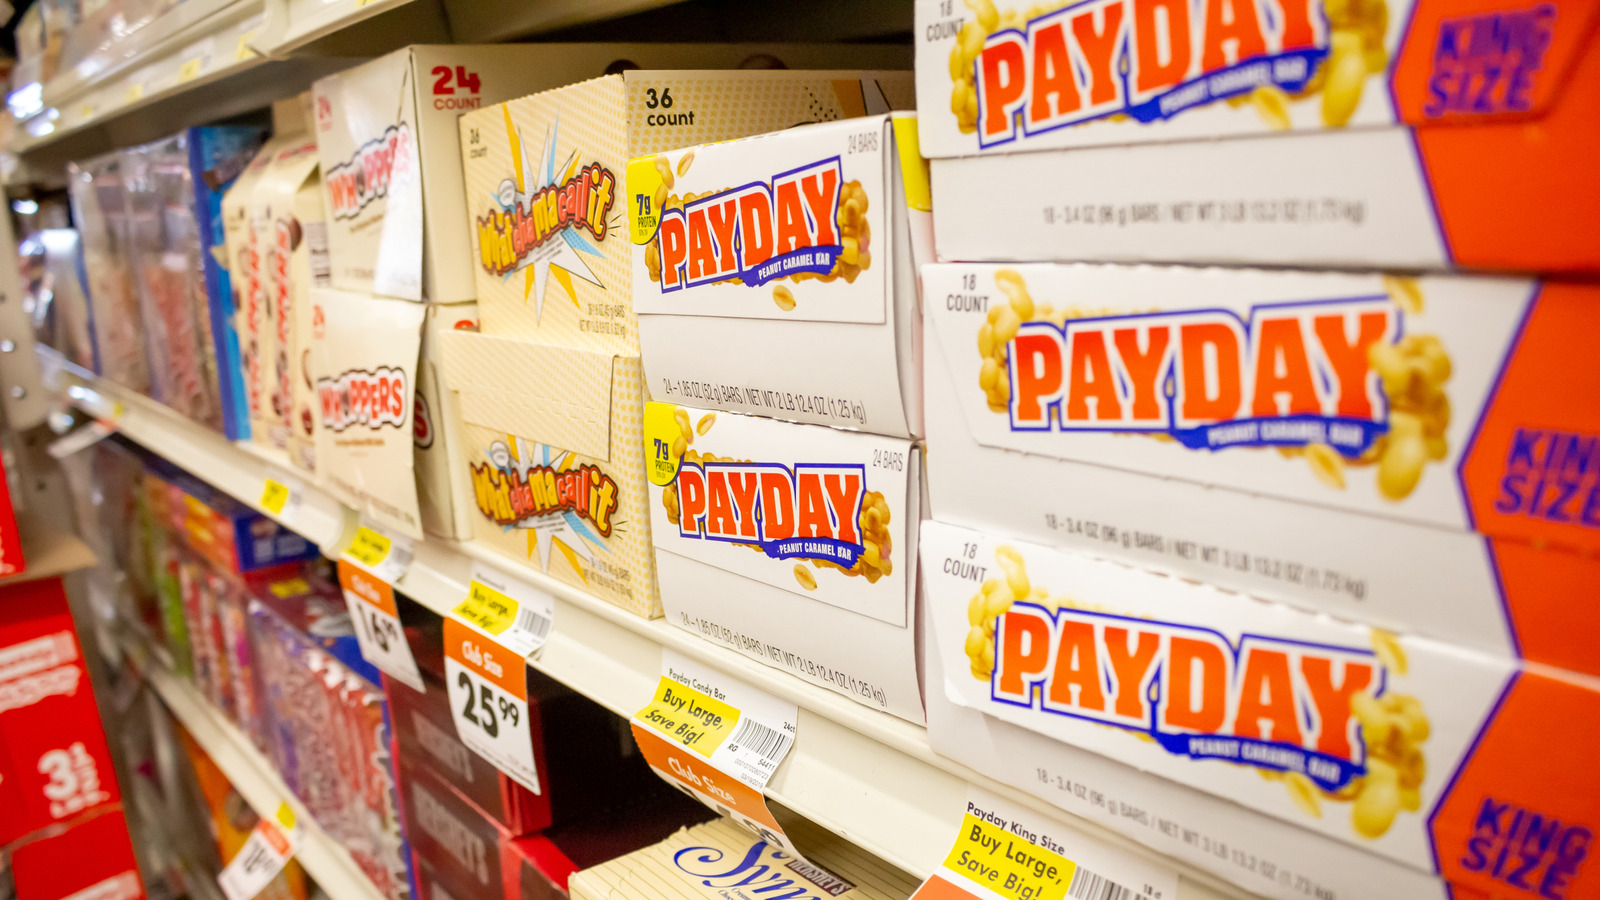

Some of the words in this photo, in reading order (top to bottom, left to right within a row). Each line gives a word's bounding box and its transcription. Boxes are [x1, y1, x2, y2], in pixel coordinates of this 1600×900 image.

[927, 18, 964, 42] COUNT
[1436, 3, 1557, 70] KING
[431, 65, 481, 96] 24
[1424, 66, 1533, 118] SIZE
[434, 97, 482, 111] COUNT
[646, 88, 673, 109] 36
[647, 110, 695, 127] count
[848, 135, 857, 154] 24
[858, 132, 878, 153] BARS
[636, 194, 651, 216] 7g
[637, 216, 657, 228] PROTEIN
[658, 168, 838, 287] PAYDAY
[758, 260, 782, 281] PEANUT
[782, 254, 814, 272] CARAMEL
[815, 251, 830, 266] BAR
[963, 274, 976, 290] 18
[946, 294, 989, 313] COUNT
[1012, 310, 1390, 422] PAYDAY
[691, 381, 703, 399] OZ
[721, 385, 743, 404] BARS
[745, 388, 762, 407] NET
[760, 390, 777, 408] WT
[775, 392, 784, 410] 2
[781, 392, 796, 412] LB
[795, 394, 815, 414] 12.4
[814, 396, 828, 416] OZ
[827, 397, 851, 420] (1.25
[850, 400, 868, 425] kg)
[653, 438, 669, 461] 7g
[655, 459, 675, 474] PROTEIN
[873, 448, 884, 468] 24
[884, 451, 903, 472] BARS
[1508, 428, 1600, 475] KIN
[677, 469, 861, 545] PAYDAY
[779, 542, 803, 556] PEANUT
[804, 542, 836, 557] CARAMEL
[837, 545, 852, 561] BAR
[963, 542, 978, 560] 18
[943, 557, 988, 584] COUNT
[668, 667, 691, 688] Payday
[692, 678, 713, 697] Candy
[713, 688, 727, 702] Bar
[741, 634, 764, 656] BARS
[766, 645, 783, 663] NET
[782, 649, 797, 670] WT
[796, 656, 805, 672] 2
[803, 658, 817, 677] LB
[816, 663, 836, 685] 12.4
[834, 670, 849, 690] OZ
[848, 675, 872, 700] (1.25
[870, 685, 888, 708] kg)
[998, 610, 1375, 760] PAYDAY
[663, 687, 686, 712] Buy
[688, 699, 724, 731] Large,
[645, 708, 675, 730] Save
[674, 722, 705, 746] Big!
[727, 743, 739, 753] RG
[667, 756, 703, 787] Club
[702, 775, 738, 806] Size
[1036, 768, 1049, 784] 18
[1074, 783, 1088, 800] OZ
[1119, 801, 1149, 827] BARS
[1157, 818, 1180, 840] NET
[967, 801, 1007, 831] Payday
[1010, 821, 1037, 845] King
[1041, 835, 1065, 855] Size
[1476, 797, 1592, 864] KING
[969, 824, 1002, 856] Buy
[1005, 841, 1062, 885] Large,
[1461, 837, 1568, 900] SIZE
[957, 850, 999, 882] Save
[1003, 872, 1043, 900] Big!
